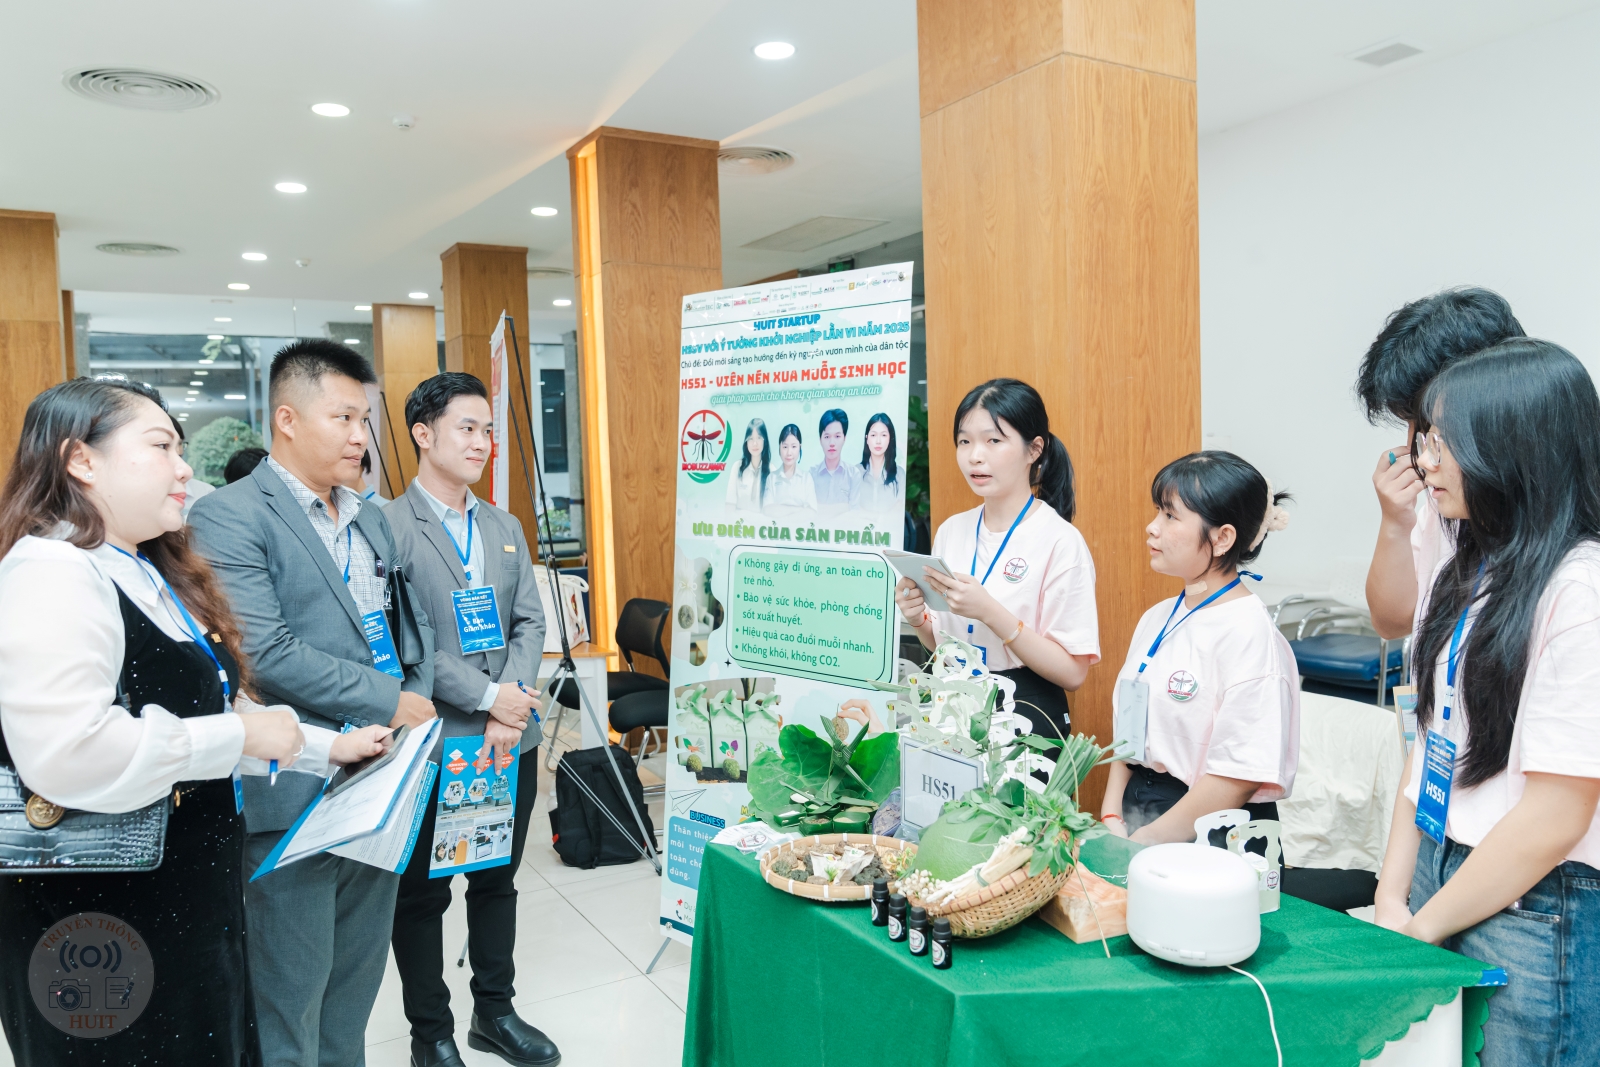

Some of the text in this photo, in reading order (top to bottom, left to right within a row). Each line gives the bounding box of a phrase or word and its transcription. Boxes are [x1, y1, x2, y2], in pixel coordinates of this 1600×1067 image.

[753, 314, 820, 331] HUIT STARTUP
[759, 332, 784, 347] KHỞI
[785, 328, 822, 345] NGHIỆP
[823, 322, 843, 340] LẦN
[845, 327, 856, 338] VI
[858, 321, 882, 337] NĂM
[884, 321, 910, 334] 2025
[728, 356, 741, 365] sáng
[743, 356, 753, 365] tạo
[754, 353, 774, 363] hướng
[775, 350, 788, 360] đến
[845, 344, 863, 354] mình
[879, 341, 894, 350] dân
[895, 340, 909, 350] tộc
[681, 377, 707, 390] HS51
[716, 371, 744, 387] VIÊN
[773, 370, 798, 383] XUA
[801, 360, 836, 381] MUỖI
[840, 363, 874, 378] SINH
[878, 361, 906, 379] HỌC
[766, 390, 780, 401] cho
[780, 389, 804, 402] không
[806, 388, 825, 400] gian
[827, 386, 845, 399] sống
[848, 386, 860, 396] an
[861, 384, 880, 395] toàn
[692, 518, 891, 546] ƯU ĐIỂM CỦA SẢN PHẨM
[744, 558, 884, 579] Không gây dị ứng, an toàn cho
[742, 608, 802, 627] sốt xuất huyết.
[743, 591, 759, 603] Bảo
[763, 594, 772, 605] vệ
[776, 595, 790, 606] sức
[820, 600, 849, 616] phòng
[853, 603, 883, 620] chống
[742, 626, 761, 638] Hiệu
[780, 633, 794, 642] cao
[818, 636, 840, 649] muỗi
[843, 640, 874, 654] nhanh.
[741, 643, 840, 667] Không khói, không CO2.
[922, 774, 955, 801] HS51
[1426, 780, 1445, 806] HS51
[673, 824, 691, 836] Thân
[690, 810, 725, 829] BUSINESS
[670, 839, 704, 854] môi trườ
